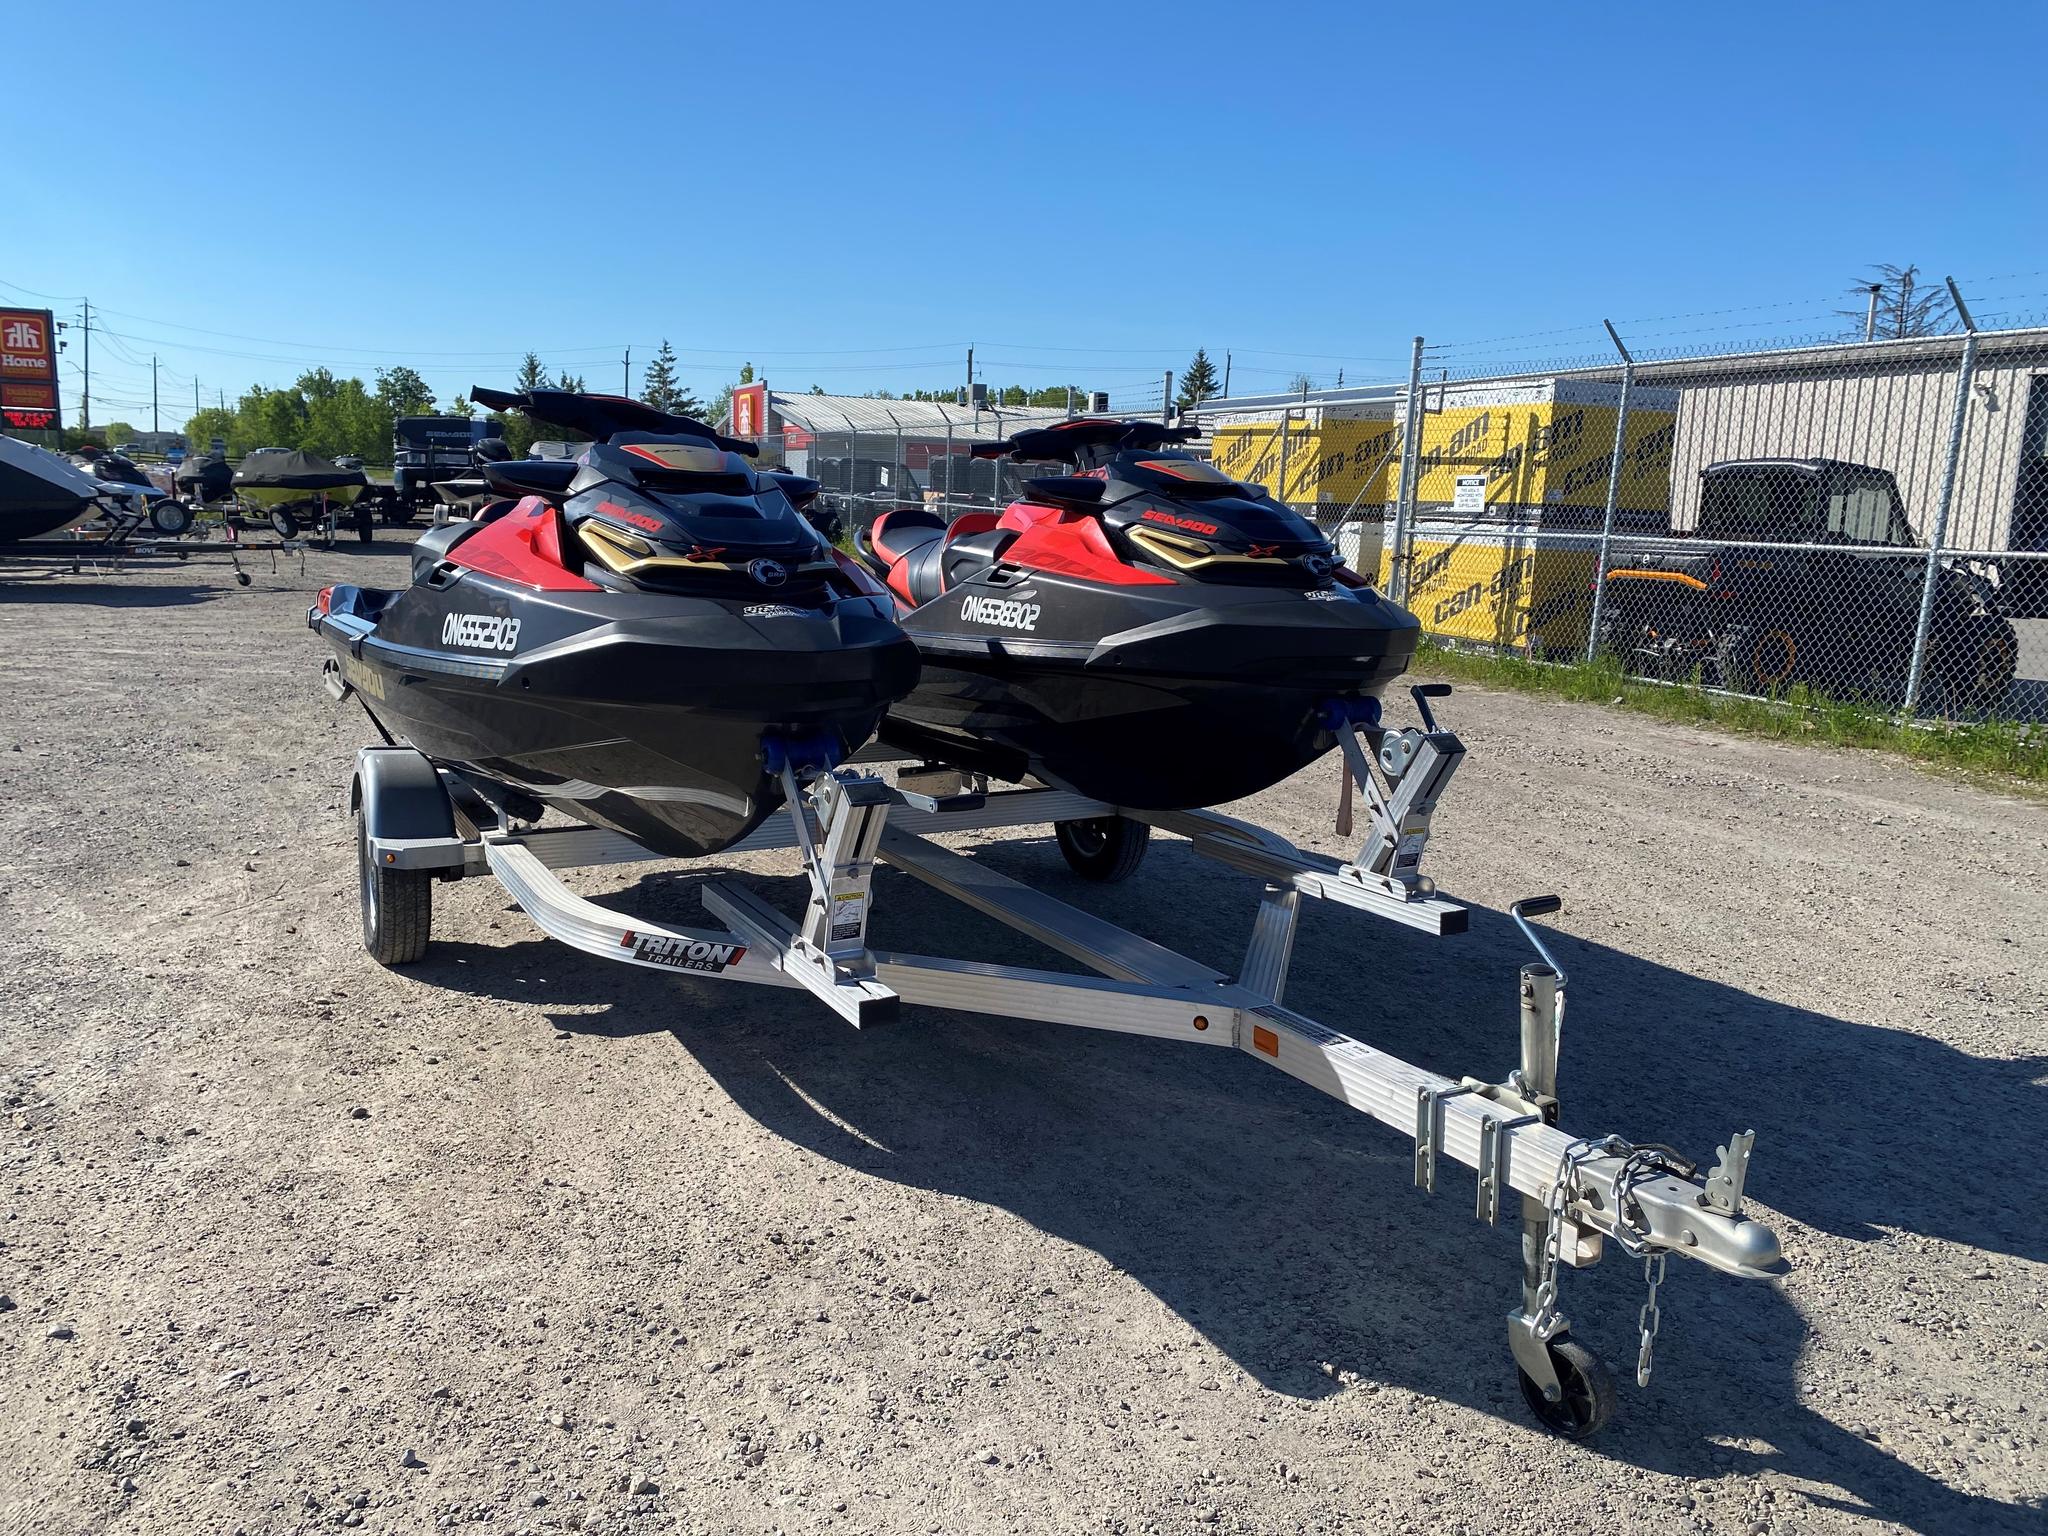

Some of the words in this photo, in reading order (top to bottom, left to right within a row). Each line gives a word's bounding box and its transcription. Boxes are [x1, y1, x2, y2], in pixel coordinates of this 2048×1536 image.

[1, 354, 47, 368] Home
[1434, 553, 1535, 625] can-am
[960, 594, 1041, 631] ON6538302
[441, 612, 522, 652] ON6552303
[633, 932, 735, 964] TRITON
[647, 953, 714, 971] TRAILERS
